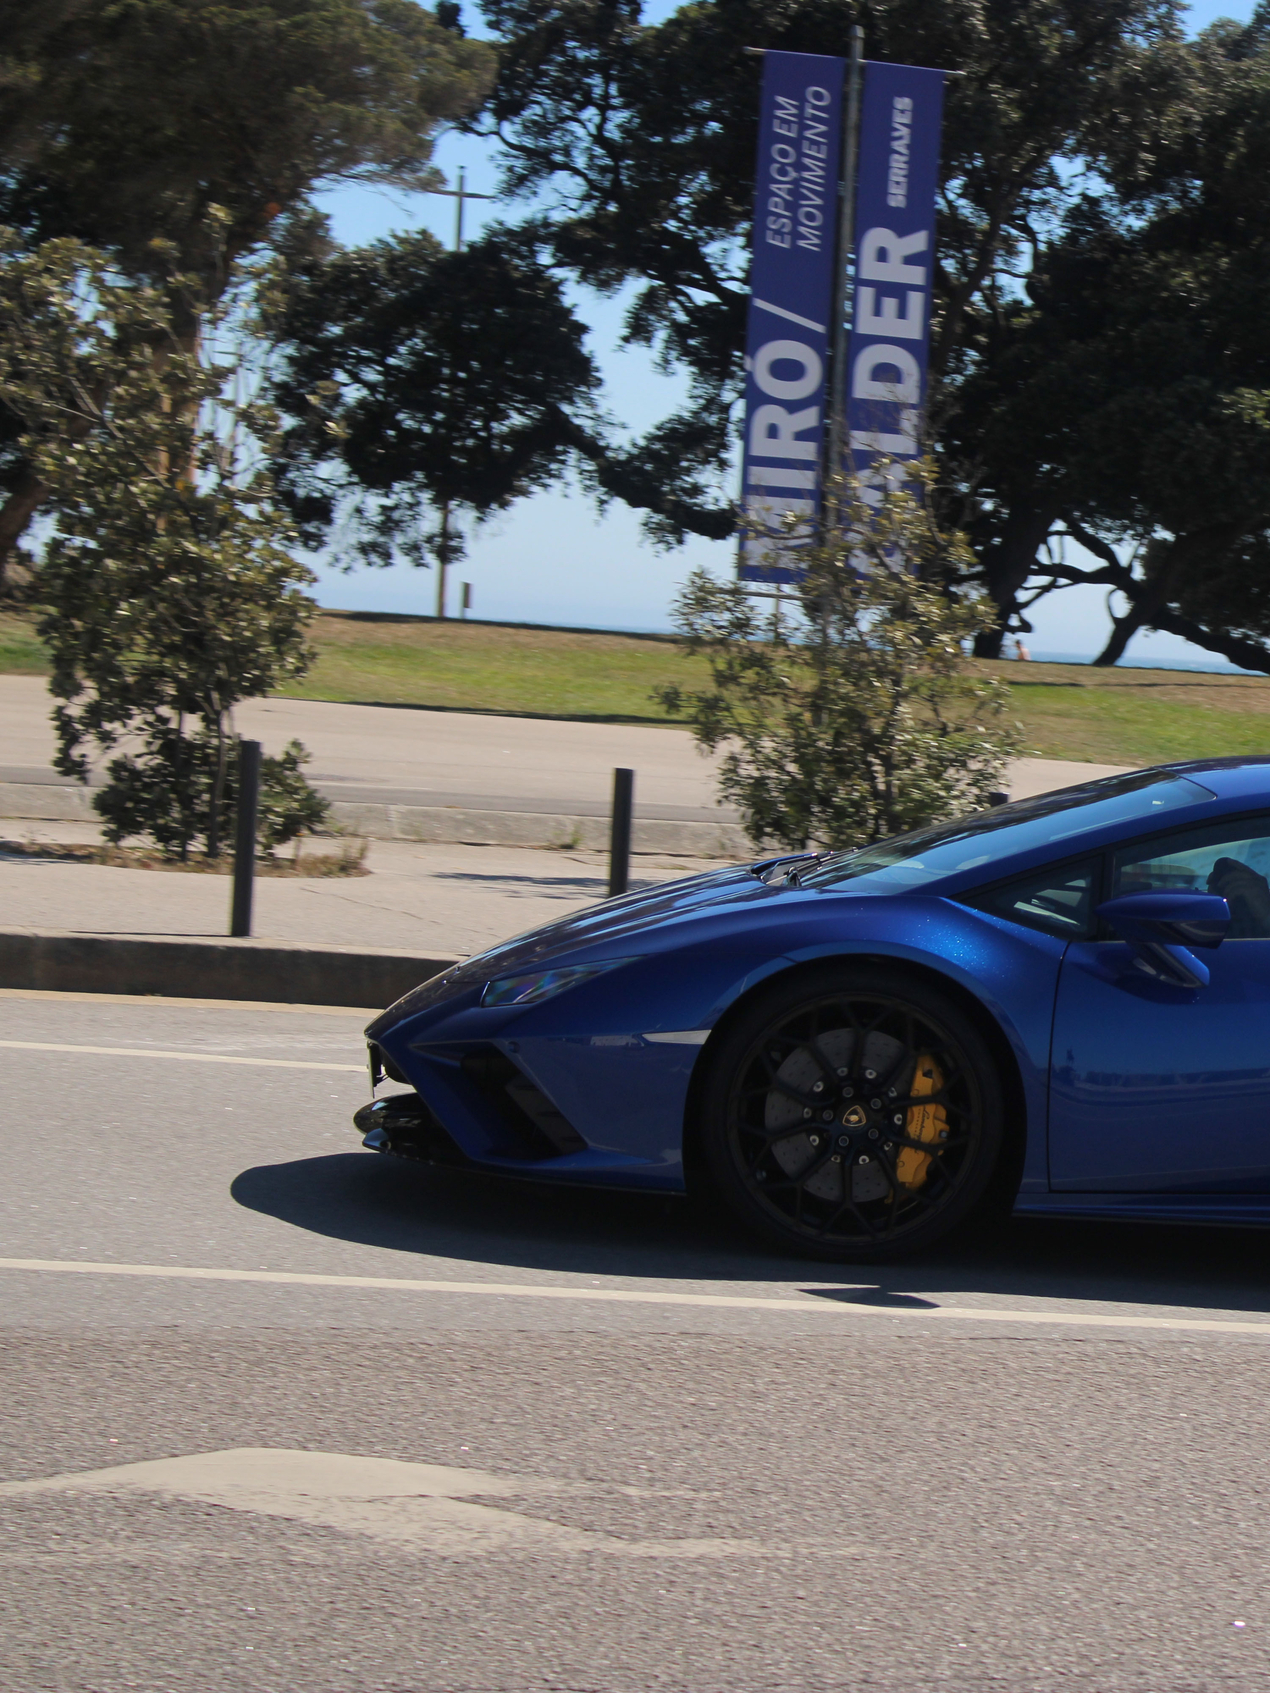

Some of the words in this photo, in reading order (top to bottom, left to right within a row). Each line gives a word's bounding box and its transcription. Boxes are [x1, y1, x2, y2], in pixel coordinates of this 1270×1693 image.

[772, 94, 800, 138] EM
[796, 85, 832, 252] MOVIMENTO
[765, 143, 800, 249] ESPAÇO
